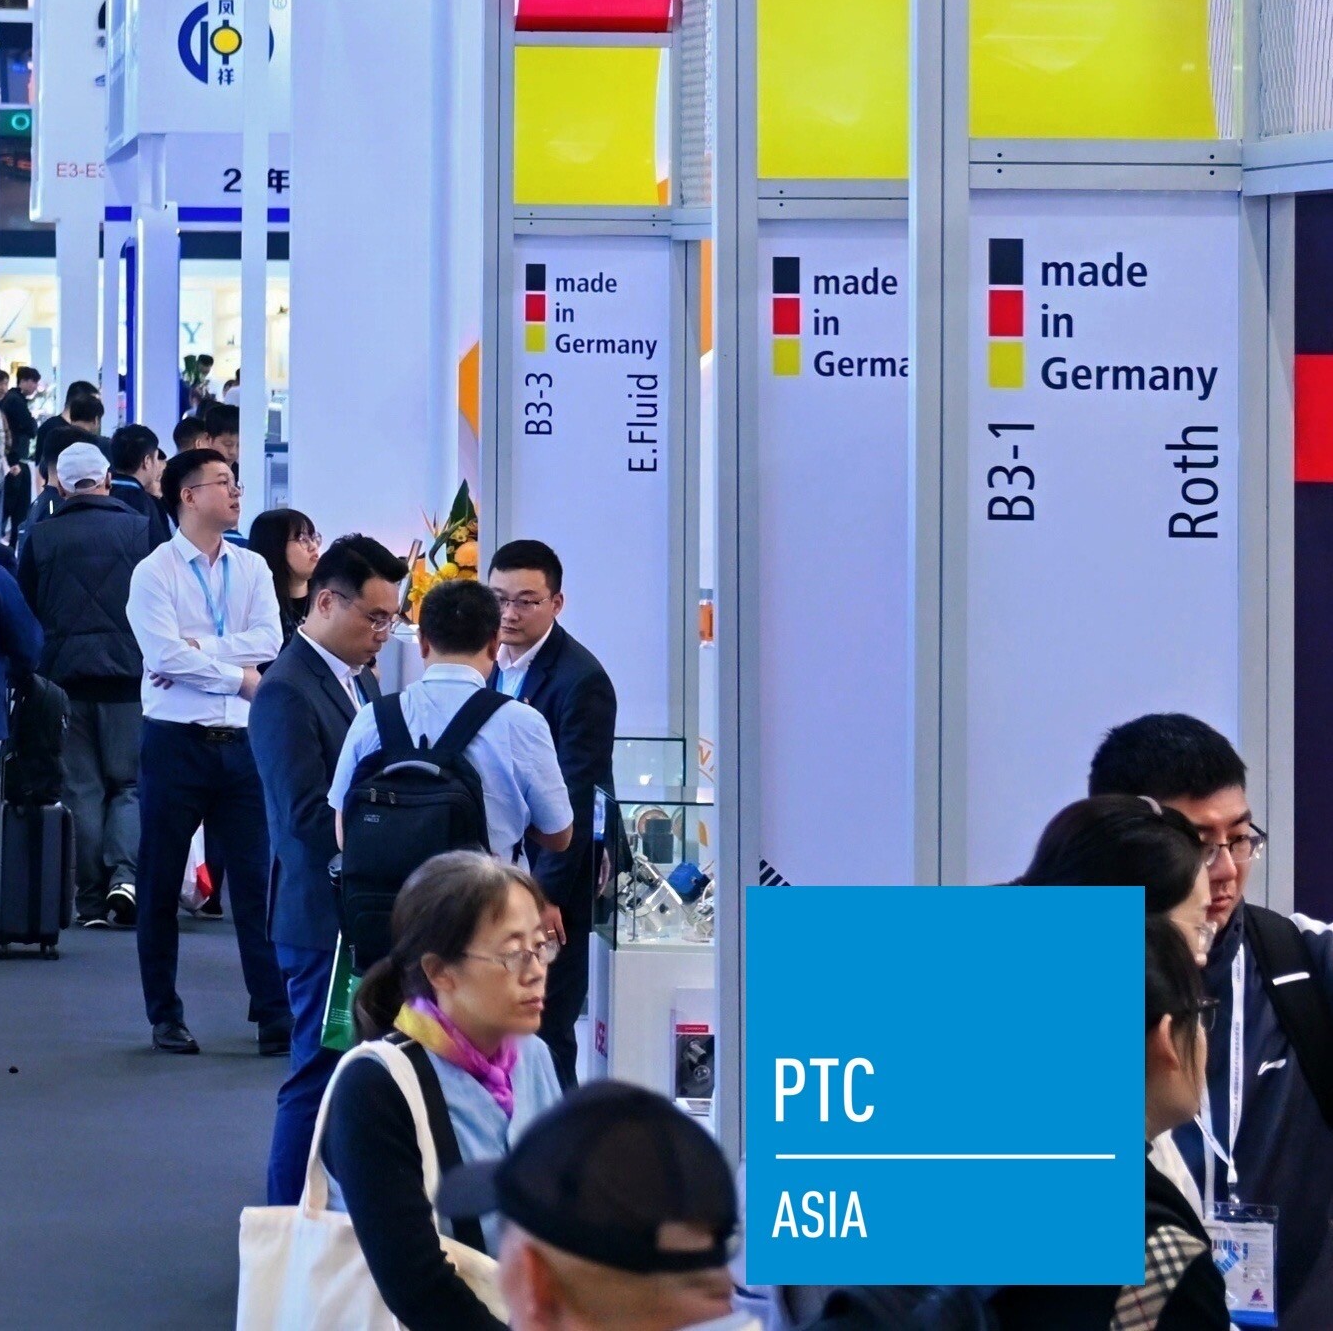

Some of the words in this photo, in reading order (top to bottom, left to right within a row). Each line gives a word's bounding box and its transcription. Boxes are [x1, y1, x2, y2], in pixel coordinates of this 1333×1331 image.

[555, 273, 617, 294] made
[813, 267, 898, 296] made
[1040, 251, 1148, 288] made
[555, 302, 575, 324] in
[813, 306, 840, 336] in
[1040, 302, 1074, 338] in
[555, 332, 657, 360] Germany
[1040, 355, 1218, 401] Germany
[525, 372, 553, 436] B3-3
[627, 373, 658, 473] E.Fluid
[987, 420, 1036, 522] B3-1
[1165, 424, 1219, 539] Roth
